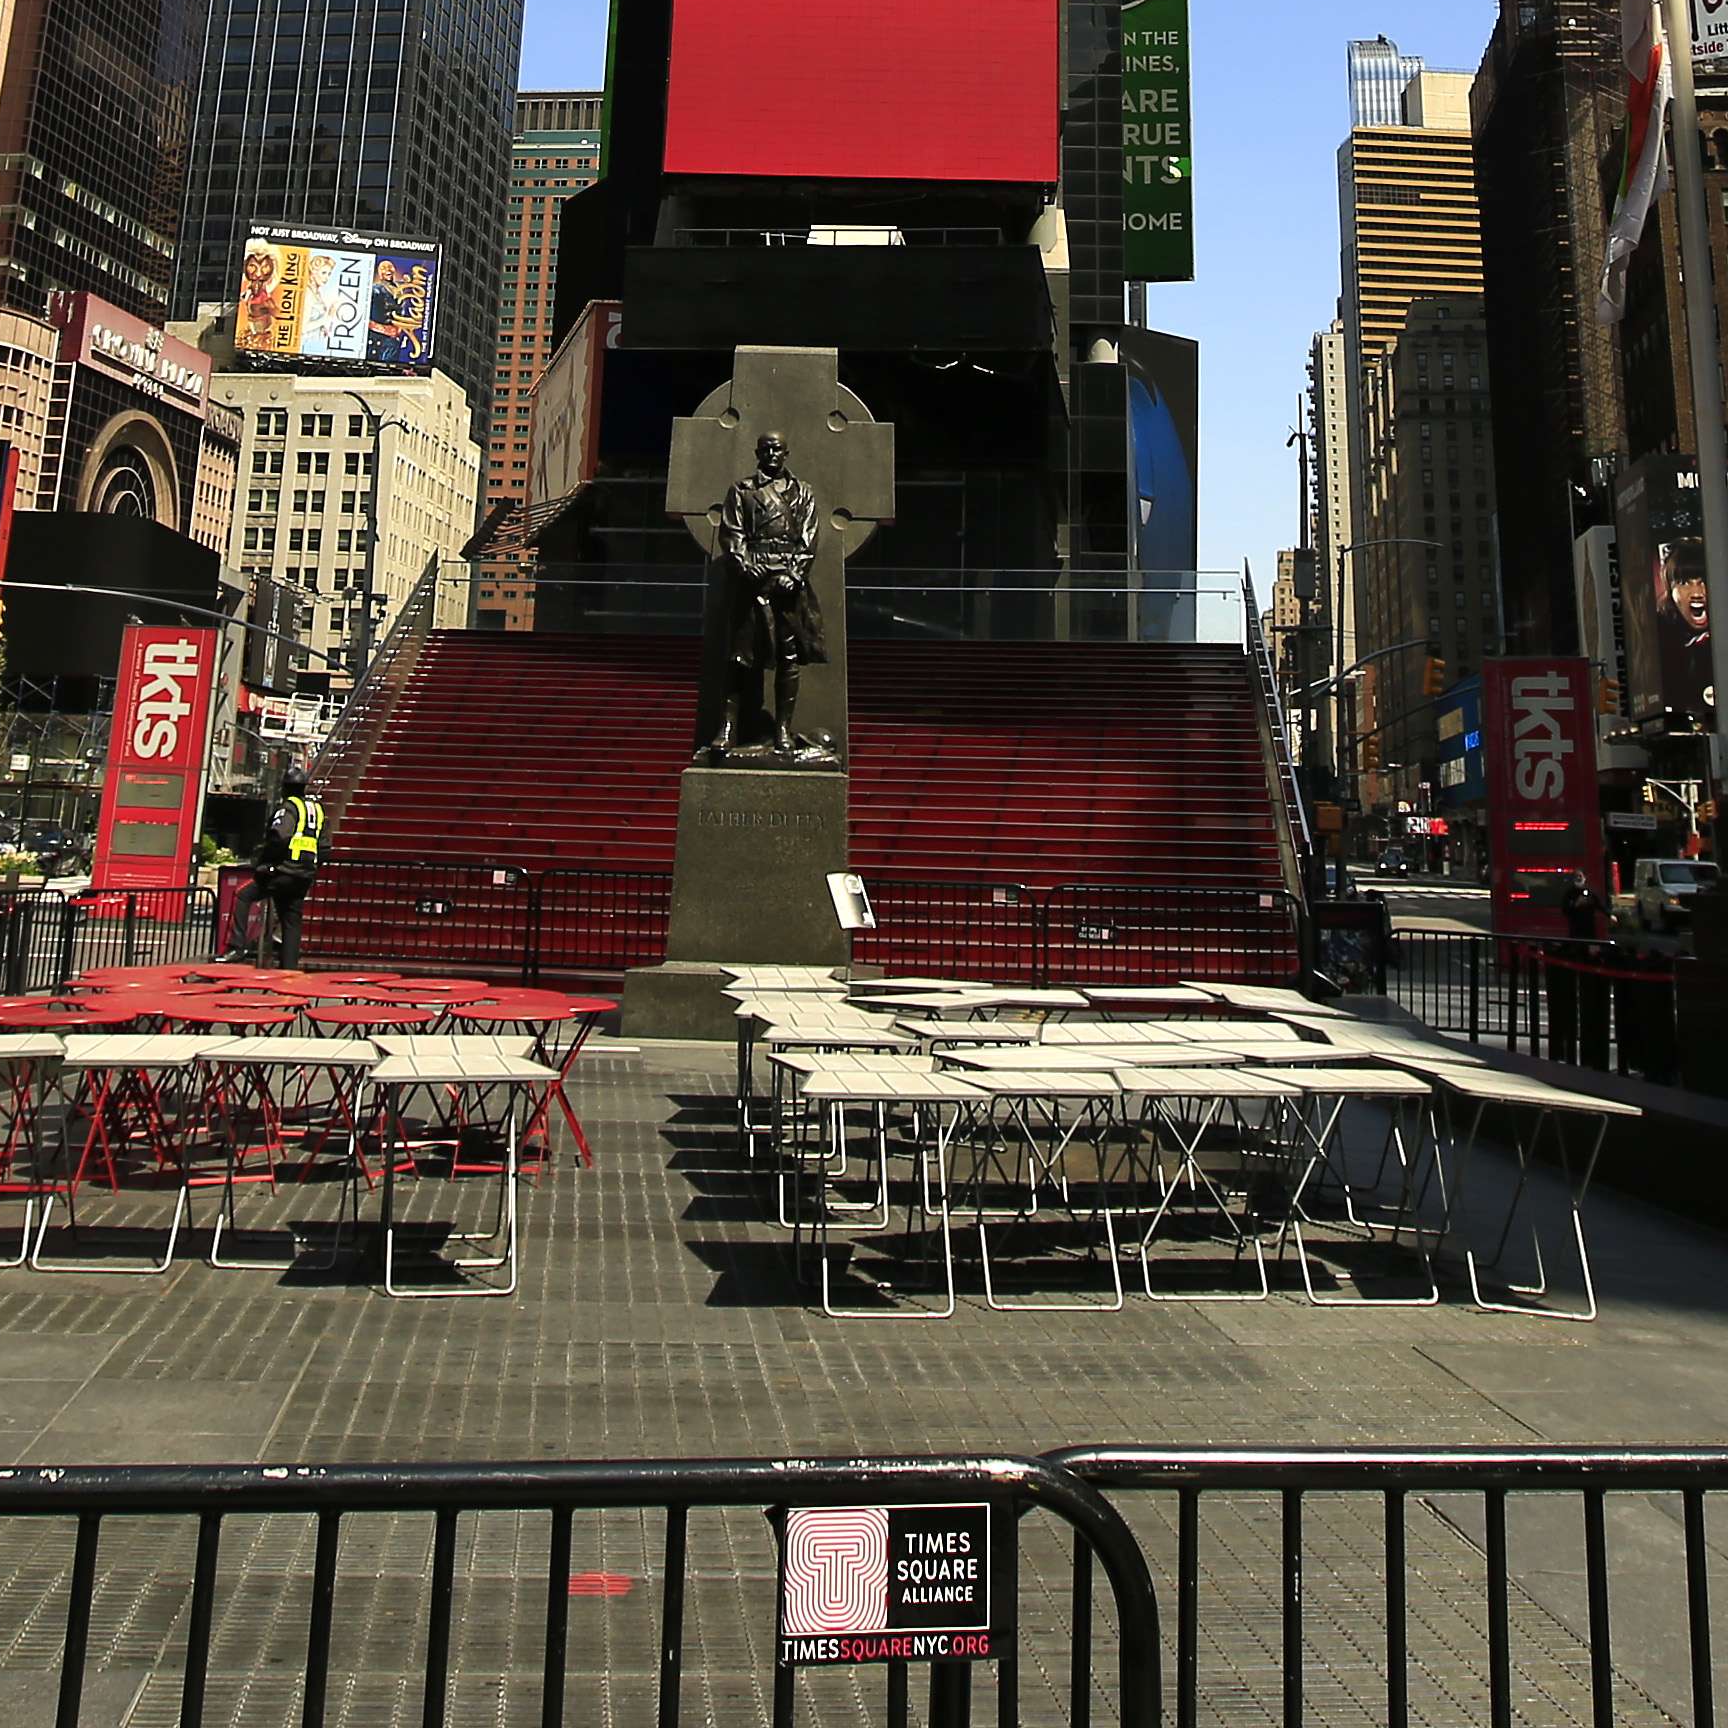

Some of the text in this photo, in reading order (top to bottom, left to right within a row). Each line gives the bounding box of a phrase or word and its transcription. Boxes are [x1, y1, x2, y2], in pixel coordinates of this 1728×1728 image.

[1142, 30, 1180, 46] THE
[1122, 56, 1181, 74] INES,
[373, 239, 390, 248] ON
[280, 252, 300, 287] KING
[277, 291, 295, 322] LION
[327, 257, 363, 353] FROZEN
[390, 265, 429, 359] Aladdin
[277, 324, 289, 348] THE
[132, 638, 198, 762] tkts
[1511, 671, 1574, 800] tkts
[697, 808, 762, 828] FATHER
[904, 1532, 971, 1554] TIMES
[897, 1558, 978, 1584] SQUARE
[902, 1585, 973, 1604] ALLIANCE
[782, 1635, 990, 1662] TIMESSQUARENYC.ORG
